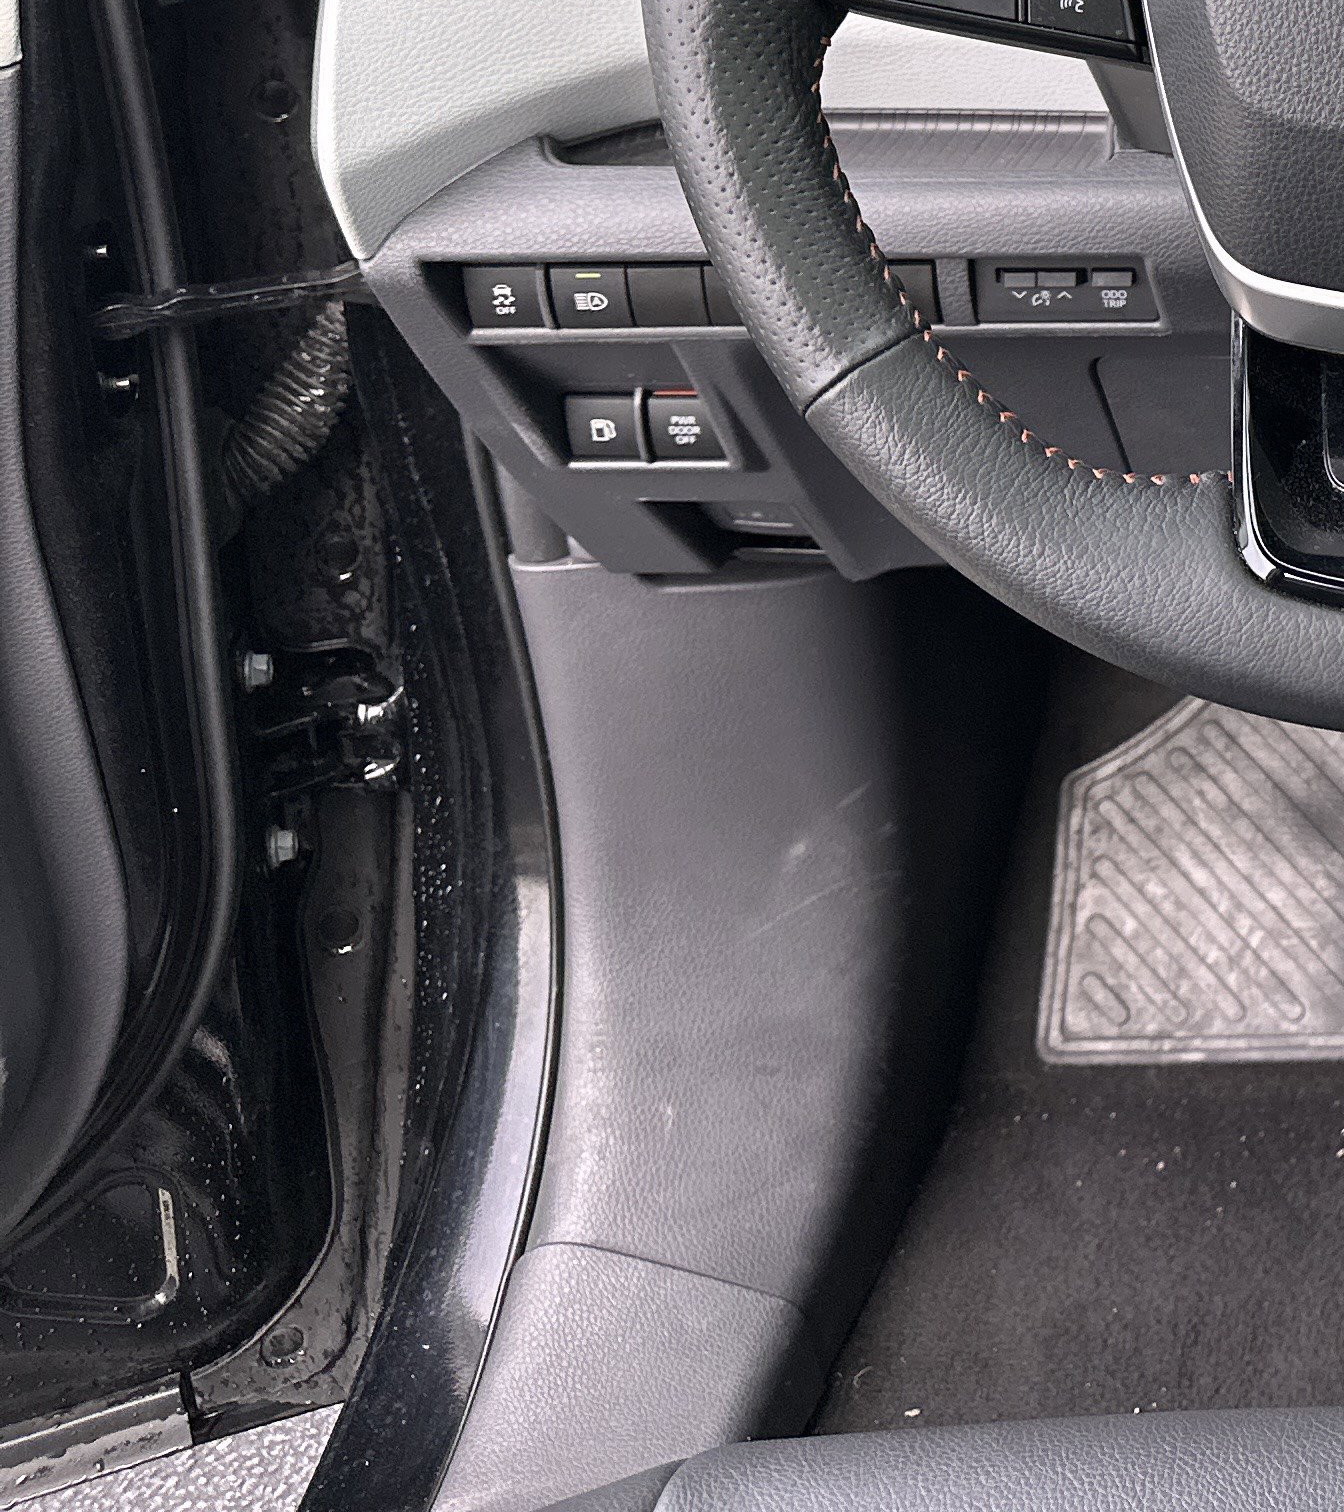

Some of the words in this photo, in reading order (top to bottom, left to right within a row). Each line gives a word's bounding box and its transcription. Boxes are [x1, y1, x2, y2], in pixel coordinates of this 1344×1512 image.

[1101, 290, 1127, 299] ODO
[1102, 299, 1127, 308] TRIP
[495, 306, 517, 315] OFF
[670, 415, 696, 425] PWR
[668, 425, 701, 435] DOOR
[676, 435, 696, 445] OFF
